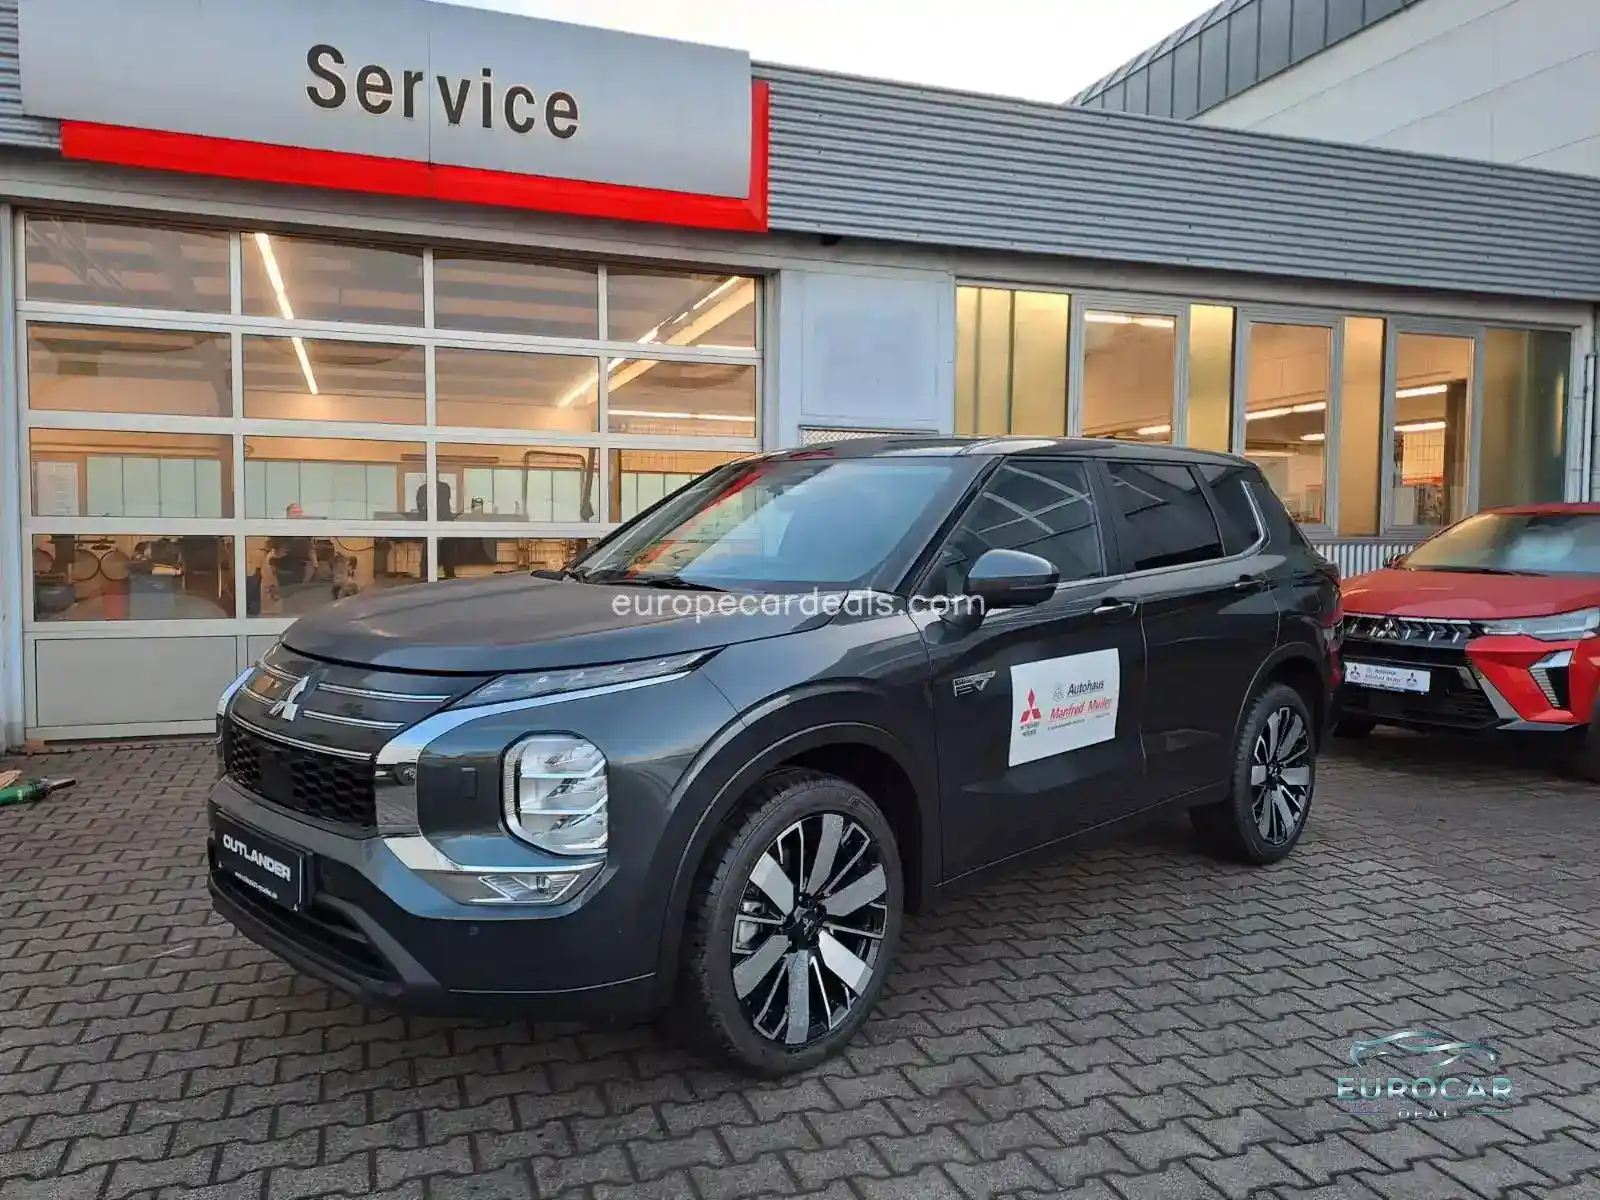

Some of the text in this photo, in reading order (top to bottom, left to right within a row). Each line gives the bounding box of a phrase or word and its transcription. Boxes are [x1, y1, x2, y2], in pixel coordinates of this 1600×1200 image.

[306, 44, 580, 139] Service
[1067, 680, 1105, 696] Autohaus
[1050, 701, 1085, 720] Manfred
[223, 834, 291, 881] OUTLANDER
